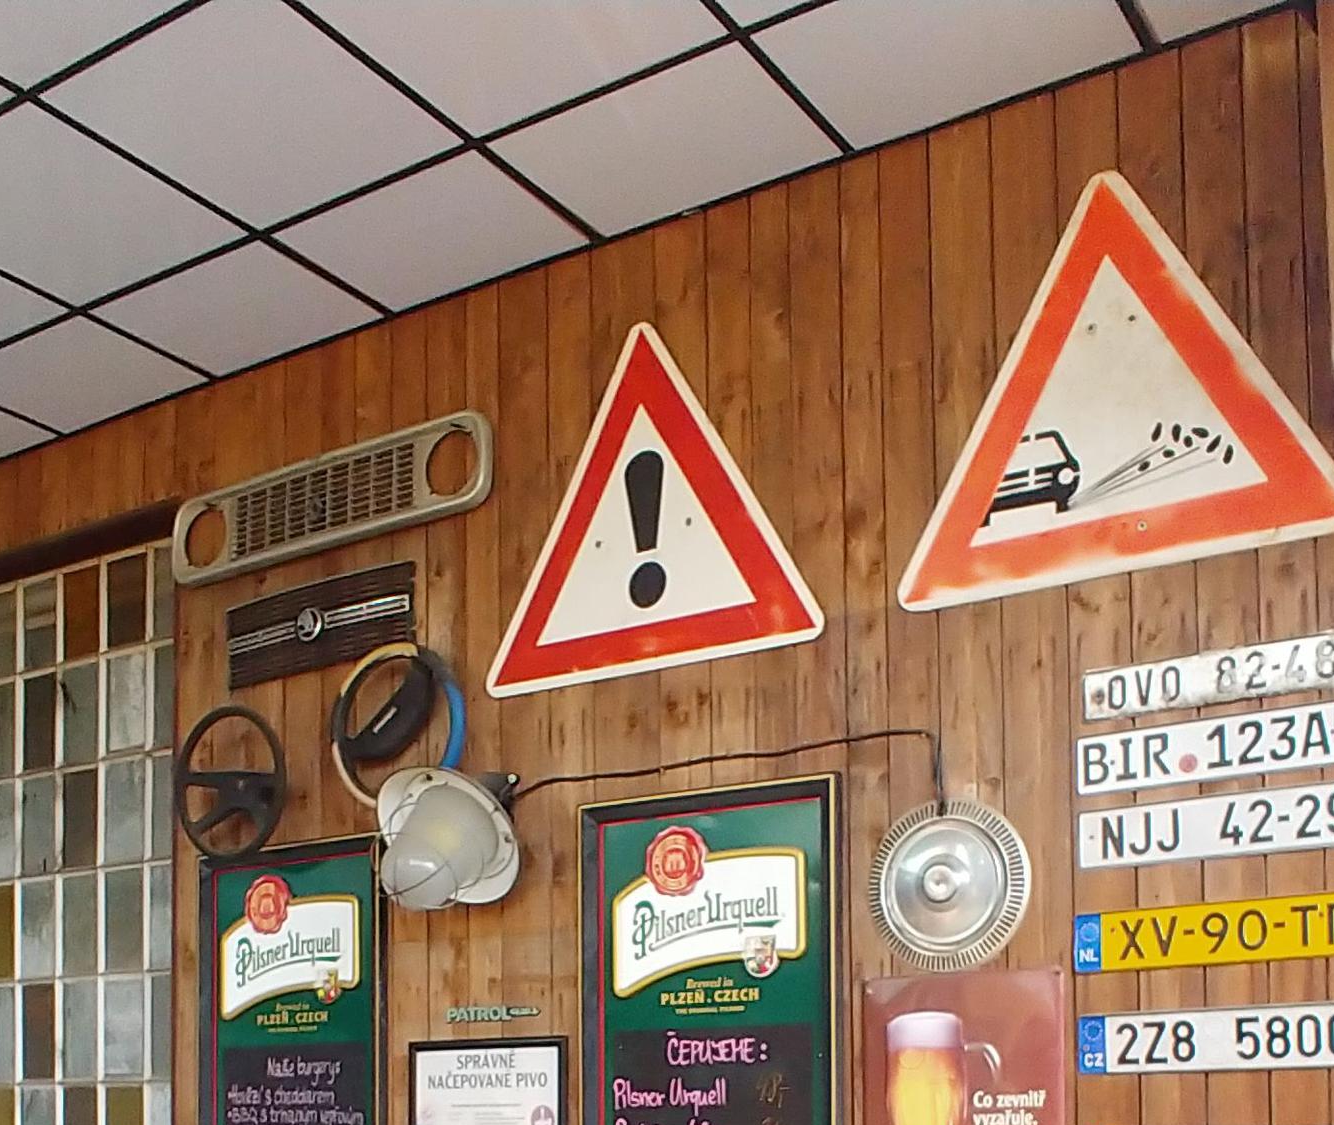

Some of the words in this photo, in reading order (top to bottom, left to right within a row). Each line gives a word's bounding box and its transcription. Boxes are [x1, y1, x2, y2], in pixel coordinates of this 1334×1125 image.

[1107, 666, 1181, 711] OVO
[1082, 733, 1170, 787] BIR
[1207, 711, 1331, 769] 123A
[1101, 808, 1180, 860] NJJ
[632, 900, 705, 960] Pilsner
[705, 887, 779, 933] Urquell
[236, 937, 288, 988] Pilsner
[288, 928, 340, 966] Urquell
[1079, 948, 1099, 963] NL
[447, 1006, 511, 1023] PATROL
[660, 989, 705, 1005] PLZEŇ
[714, 988, 759, 1002] CZECH
[1084, 1053, 1104, 1068] CZ
[1116, 1020, 1196, 1066] 2Z8
[516, 1072, 547, 1087] PIVO
[613, 1079, 665, 1110] Pilsner
[670, 1077, 726, 1117] Urquell
[973, 1090, 993, 1108] Co
[996, 1090, 1046, 1108] zevnitř
